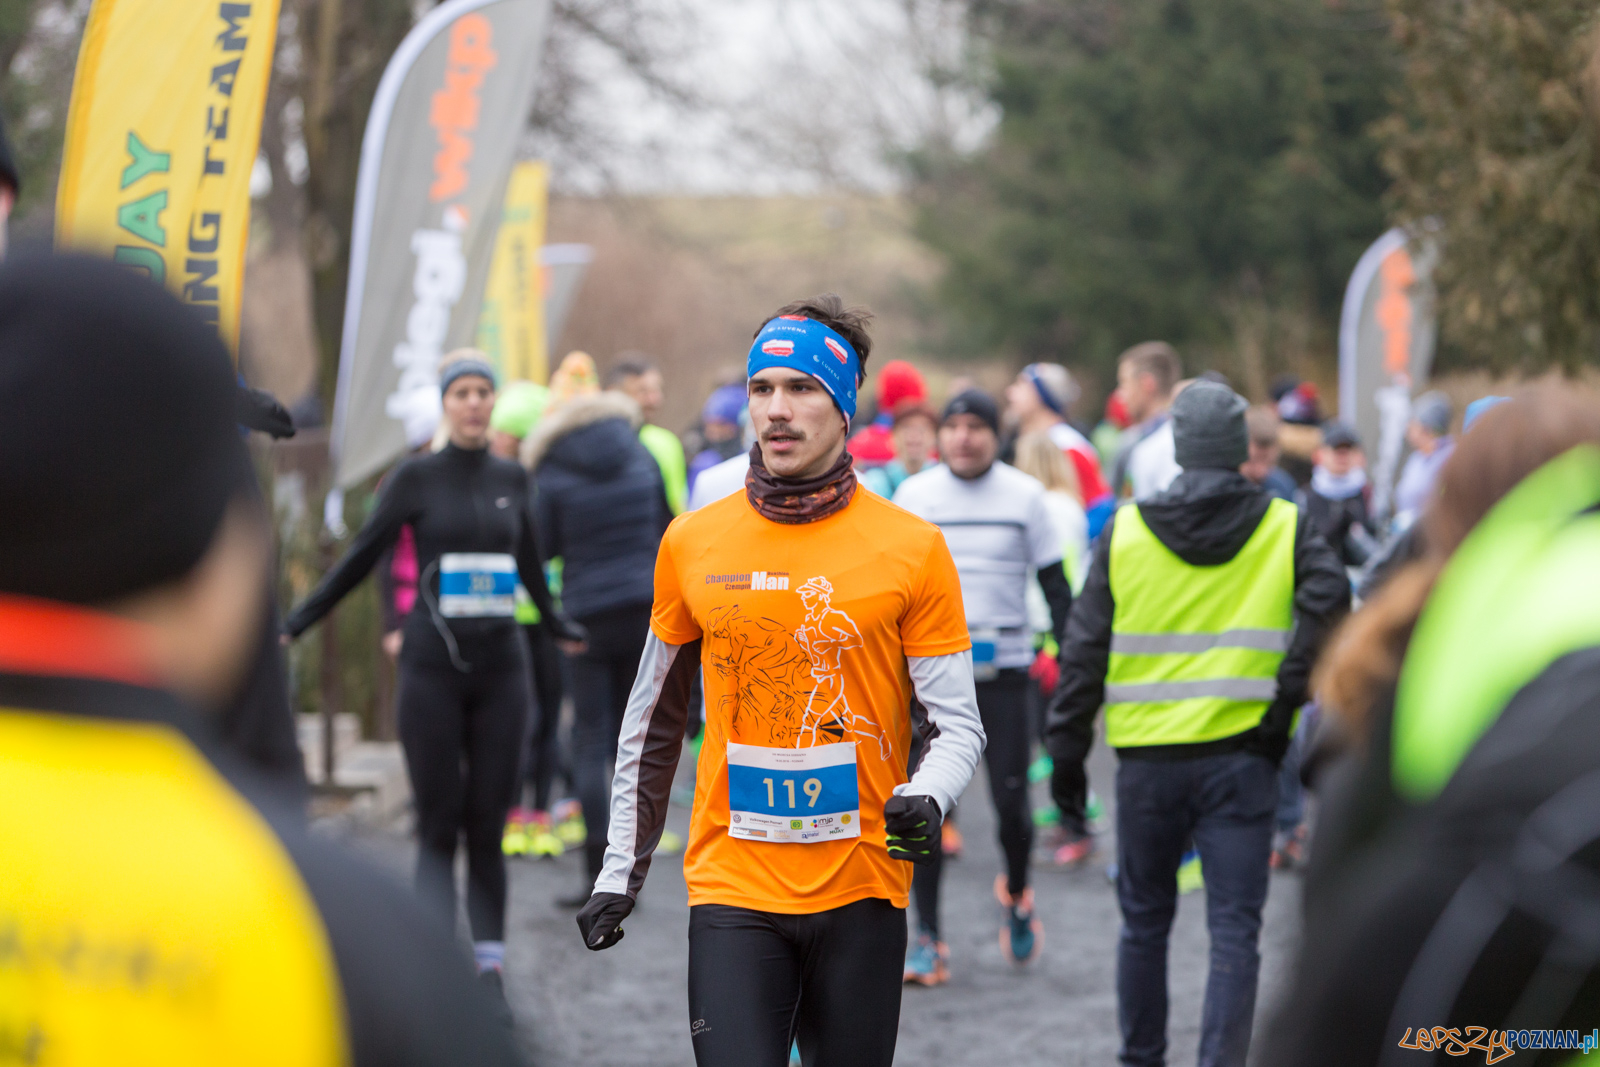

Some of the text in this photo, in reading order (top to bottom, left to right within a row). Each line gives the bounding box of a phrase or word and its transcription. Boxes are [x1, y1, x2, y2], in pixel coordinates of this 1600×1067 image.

[200, 2, 252, 181] TEAM
[777, 325, 807, 334] LUVENA
[821, 360, 840, 381] LUVENA
[706, 571, 790, 591] Champion Man
[763, 777, 822, 808] 119
